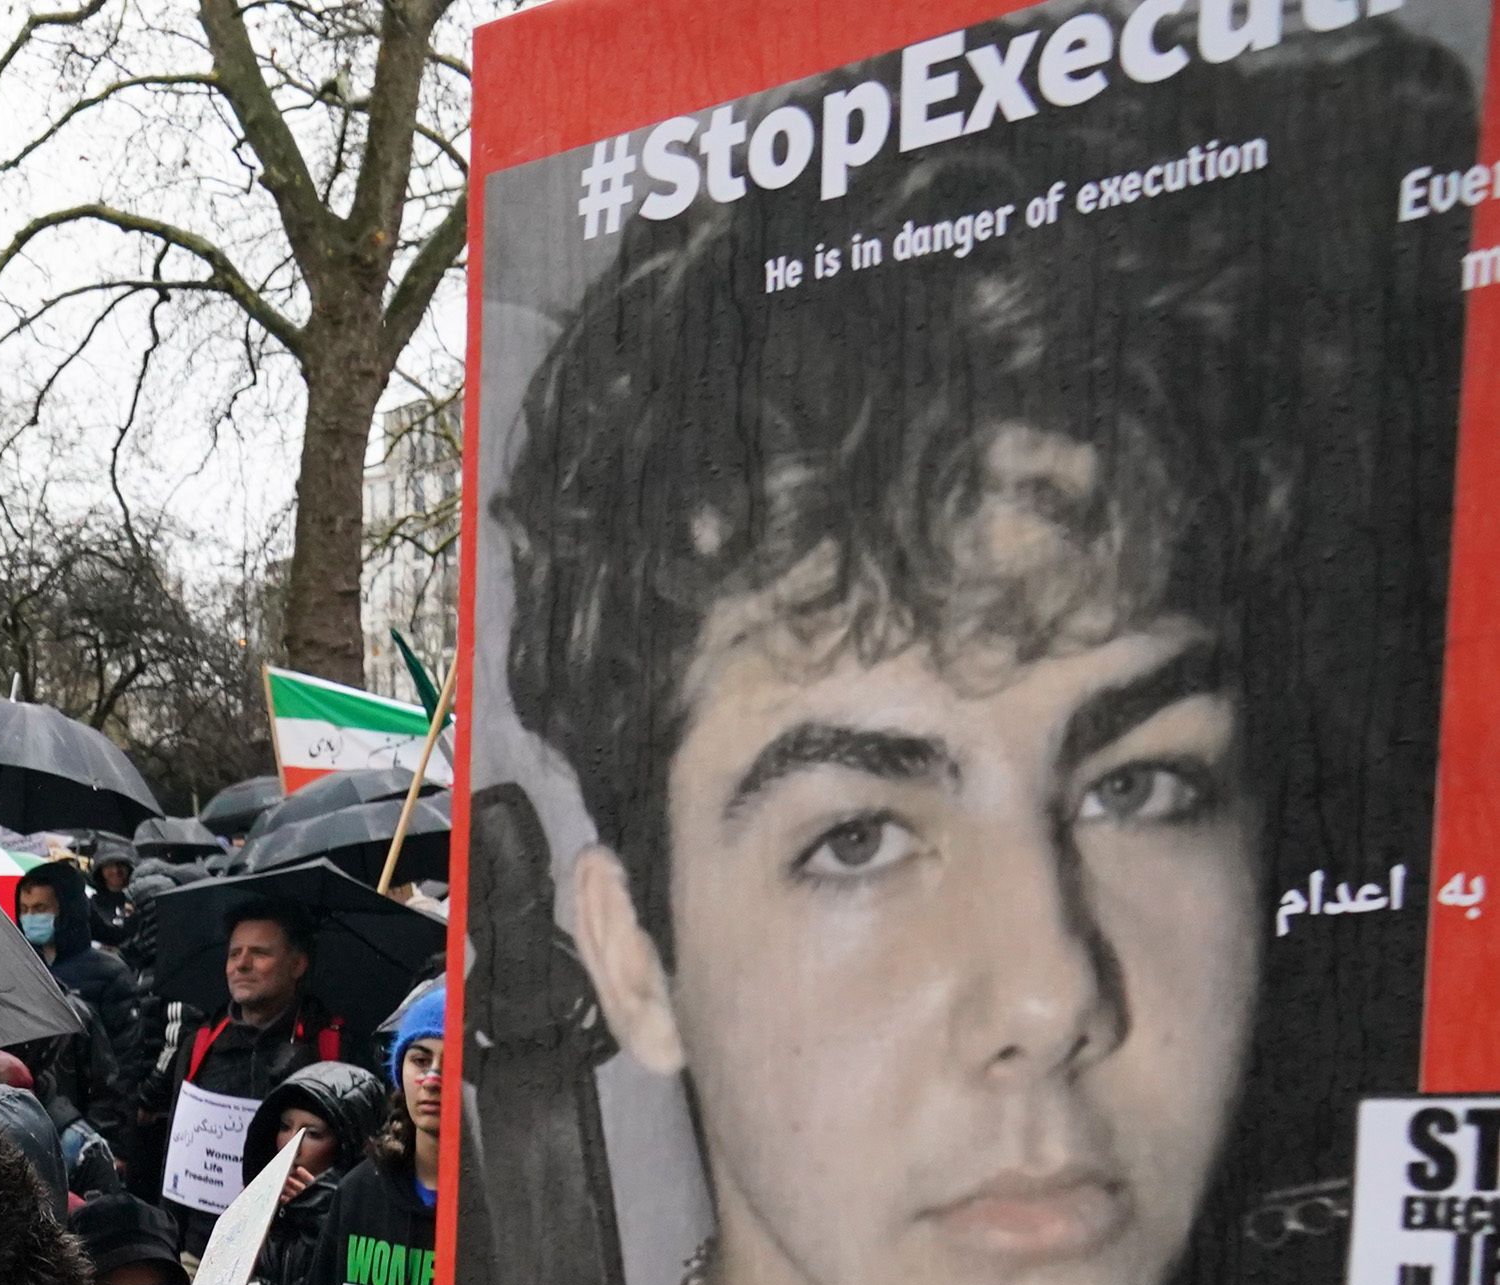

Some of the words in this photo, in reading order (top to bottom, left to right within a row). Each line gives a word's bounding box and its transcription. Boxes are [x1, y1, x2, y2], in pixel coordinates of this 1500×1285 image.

[578, 0, 1400, 240] #StopExecu
[765, 256, 802, 294] He
[814, 243, 841, 280] is
[851, 233, 881, 271] in
[893, 201, 1014, 259] danger
[1025, 180, 1066, 230] of
[1076, 134, 1268, 215] execution
[1275, 863, 1407, 938] اعدام
[1437, 871, 1487, 921] به
[184, 1168, 225, 1188] Freedom
[203, 1161, 224, 1174] Life
[1407, 1107, 1500, 1192] ST
